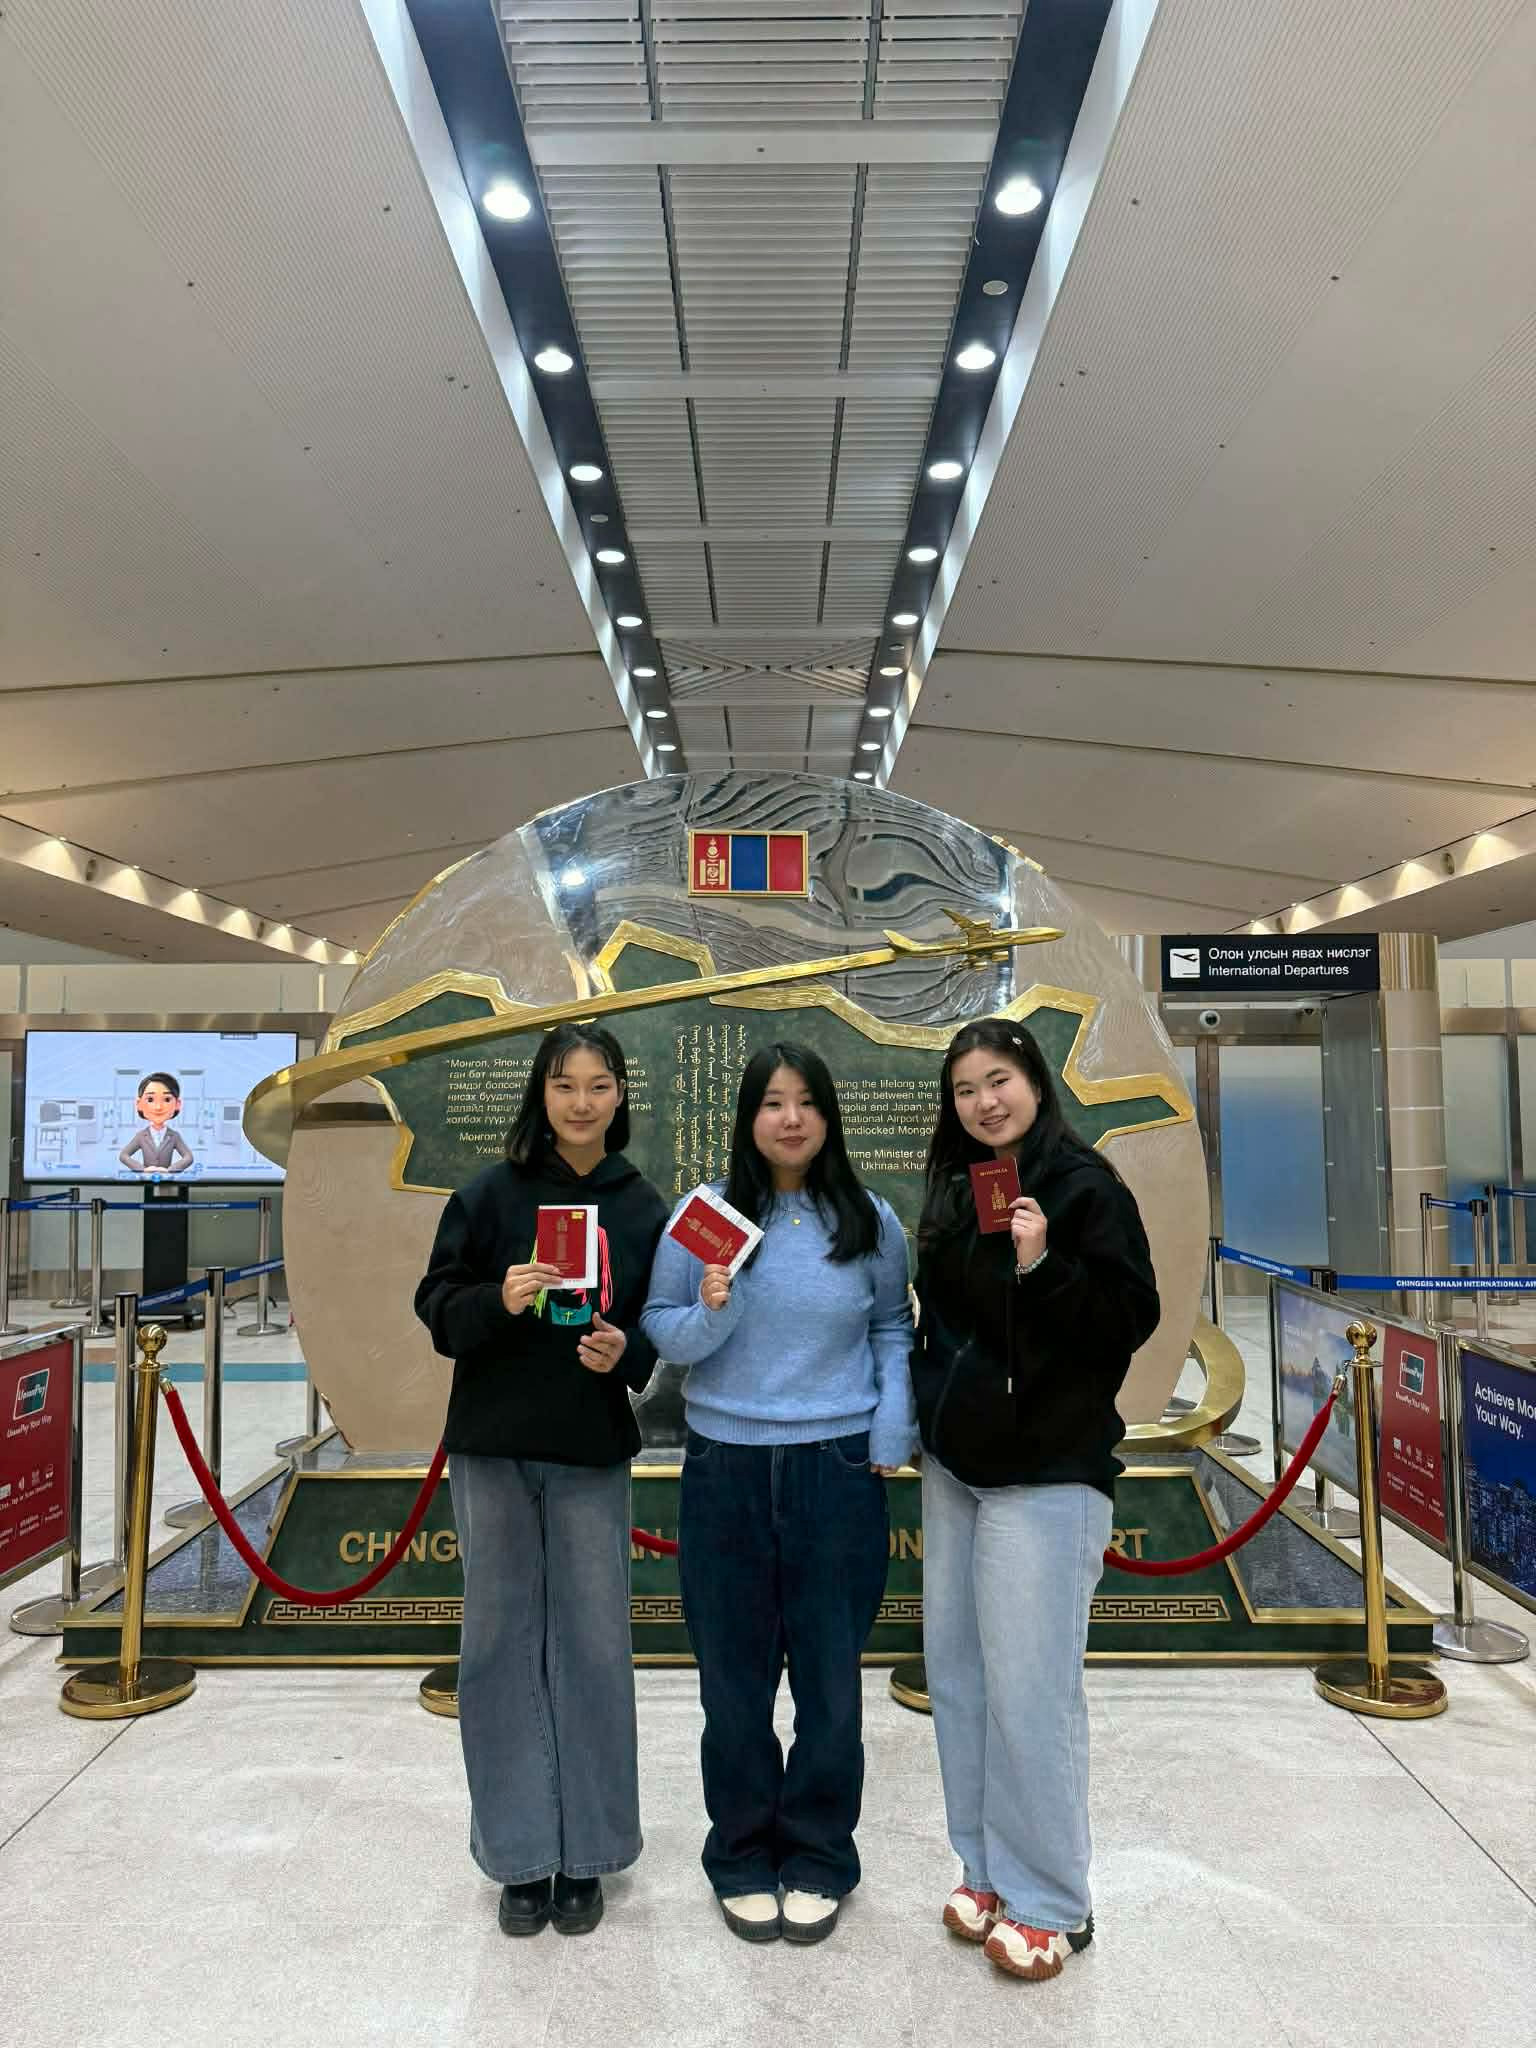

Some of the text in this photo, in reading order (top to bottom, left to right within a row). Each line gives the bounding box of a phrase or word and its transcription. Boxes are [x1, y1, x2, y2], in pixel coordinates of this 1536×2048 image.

[1208, 947, 1372, 962] Олон улсын явах нислэг
[1208, 963, 1349, 978] International Departures
[862, 1079, 877, 1089] the
[880, 1079, 915, 1090] lifelong
[873, 1090, 914, 1100] between
[917, 1090, 933, 1100] the
[870, 1102, 889, 1112] and
[887, 1114, 919, 1125] Airport
[874, 1148, 913, 1159] Minister
[917, 1148, 927, 1159] of
[1464, 1280, 1524, 1288] INTERNATIONAL
[1475, 1381, 1515, 1411] Achieve
[1475, 1403, 1524, 1440] Your Way.
